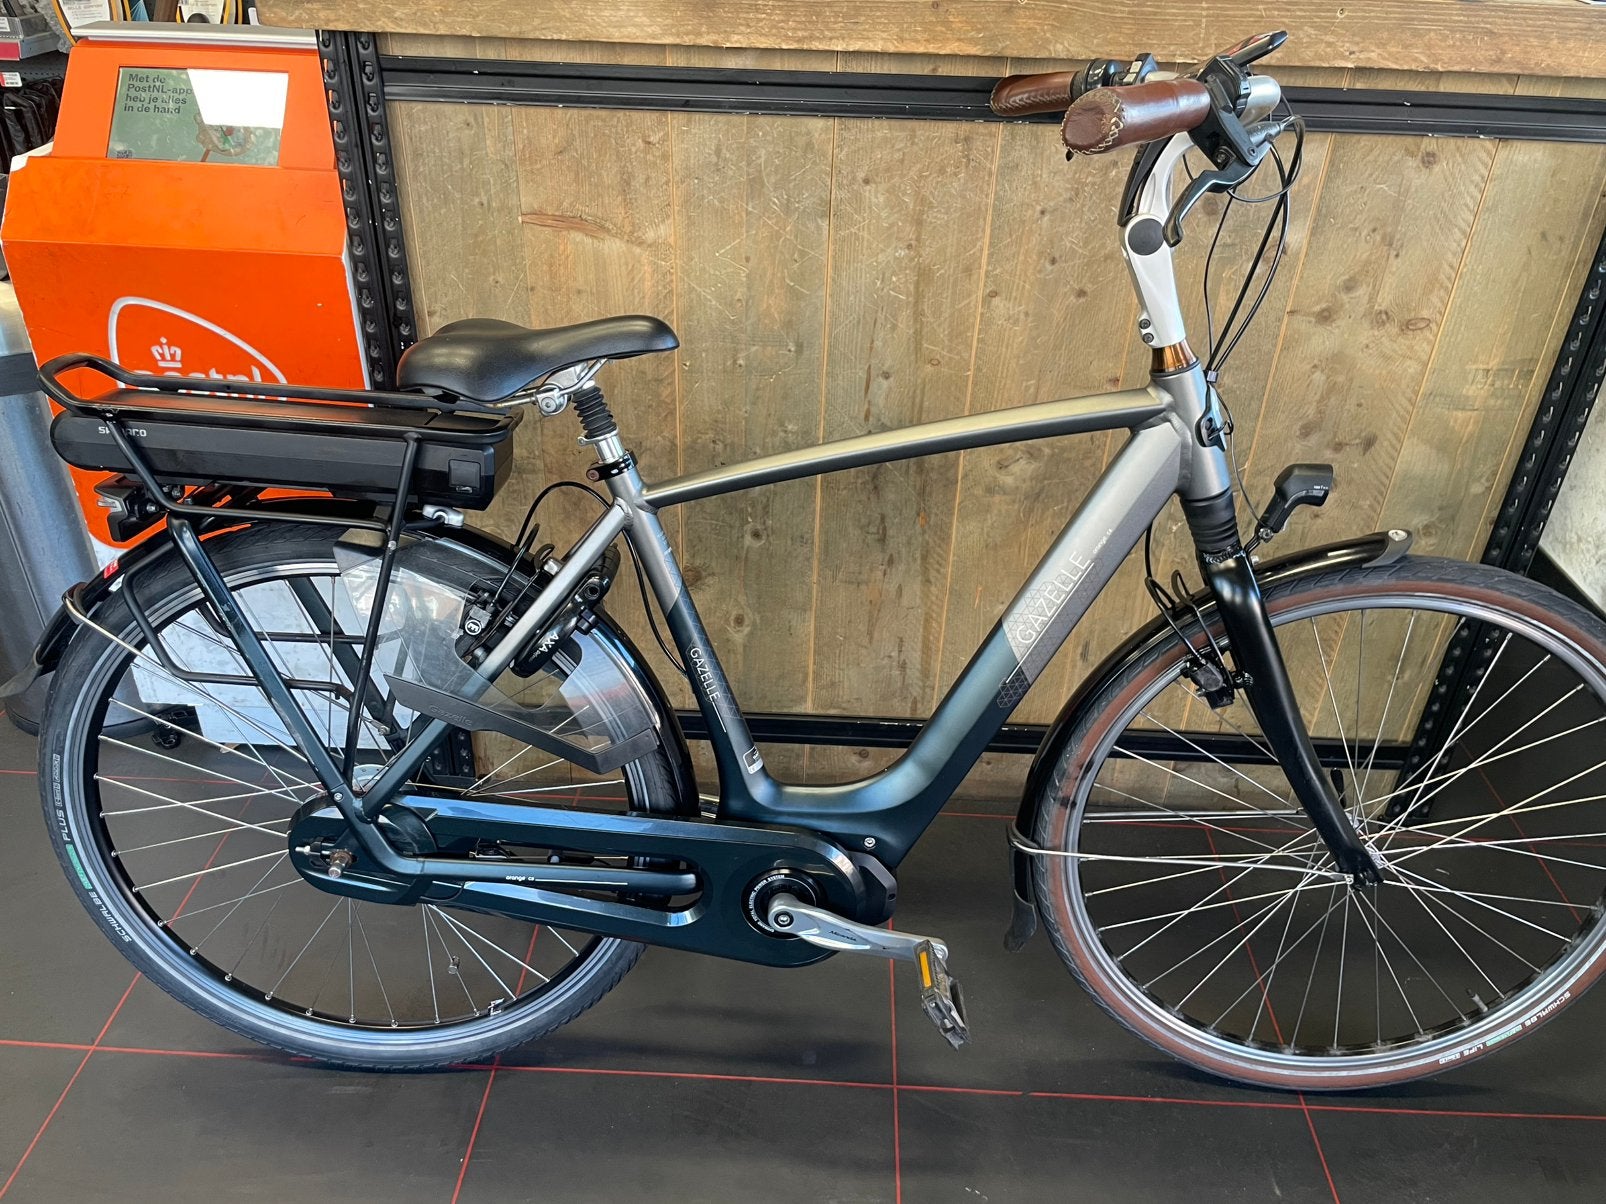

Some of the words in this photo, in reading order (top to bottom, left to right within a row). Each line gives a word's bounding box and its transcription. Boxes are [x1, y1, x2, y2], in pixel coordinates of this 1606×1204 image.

[127, 83, 193, 97] PostNL-app
[128, 73, 150, 83] Met
[152, 74, 166, 84] de
[124, 104, 134, 113] in
[137, 104, 151, 113] de
[153, 105, 181, 114] hand
[125, 94, 146, 103] heb
[147, 94, 159, 104] je
[161, 95, 187, 105] alles
[1016, 551, 1091, 644] GAZELLE
[539, 630, 560, 653] AXA
[690, 647, 721, 701] GAZELLE
[57, 808, 71, 841] PLUS
[88, 891, 133, 943] SCHWALBE
[1524, 991, 1572, 1027] SCHWALBE
